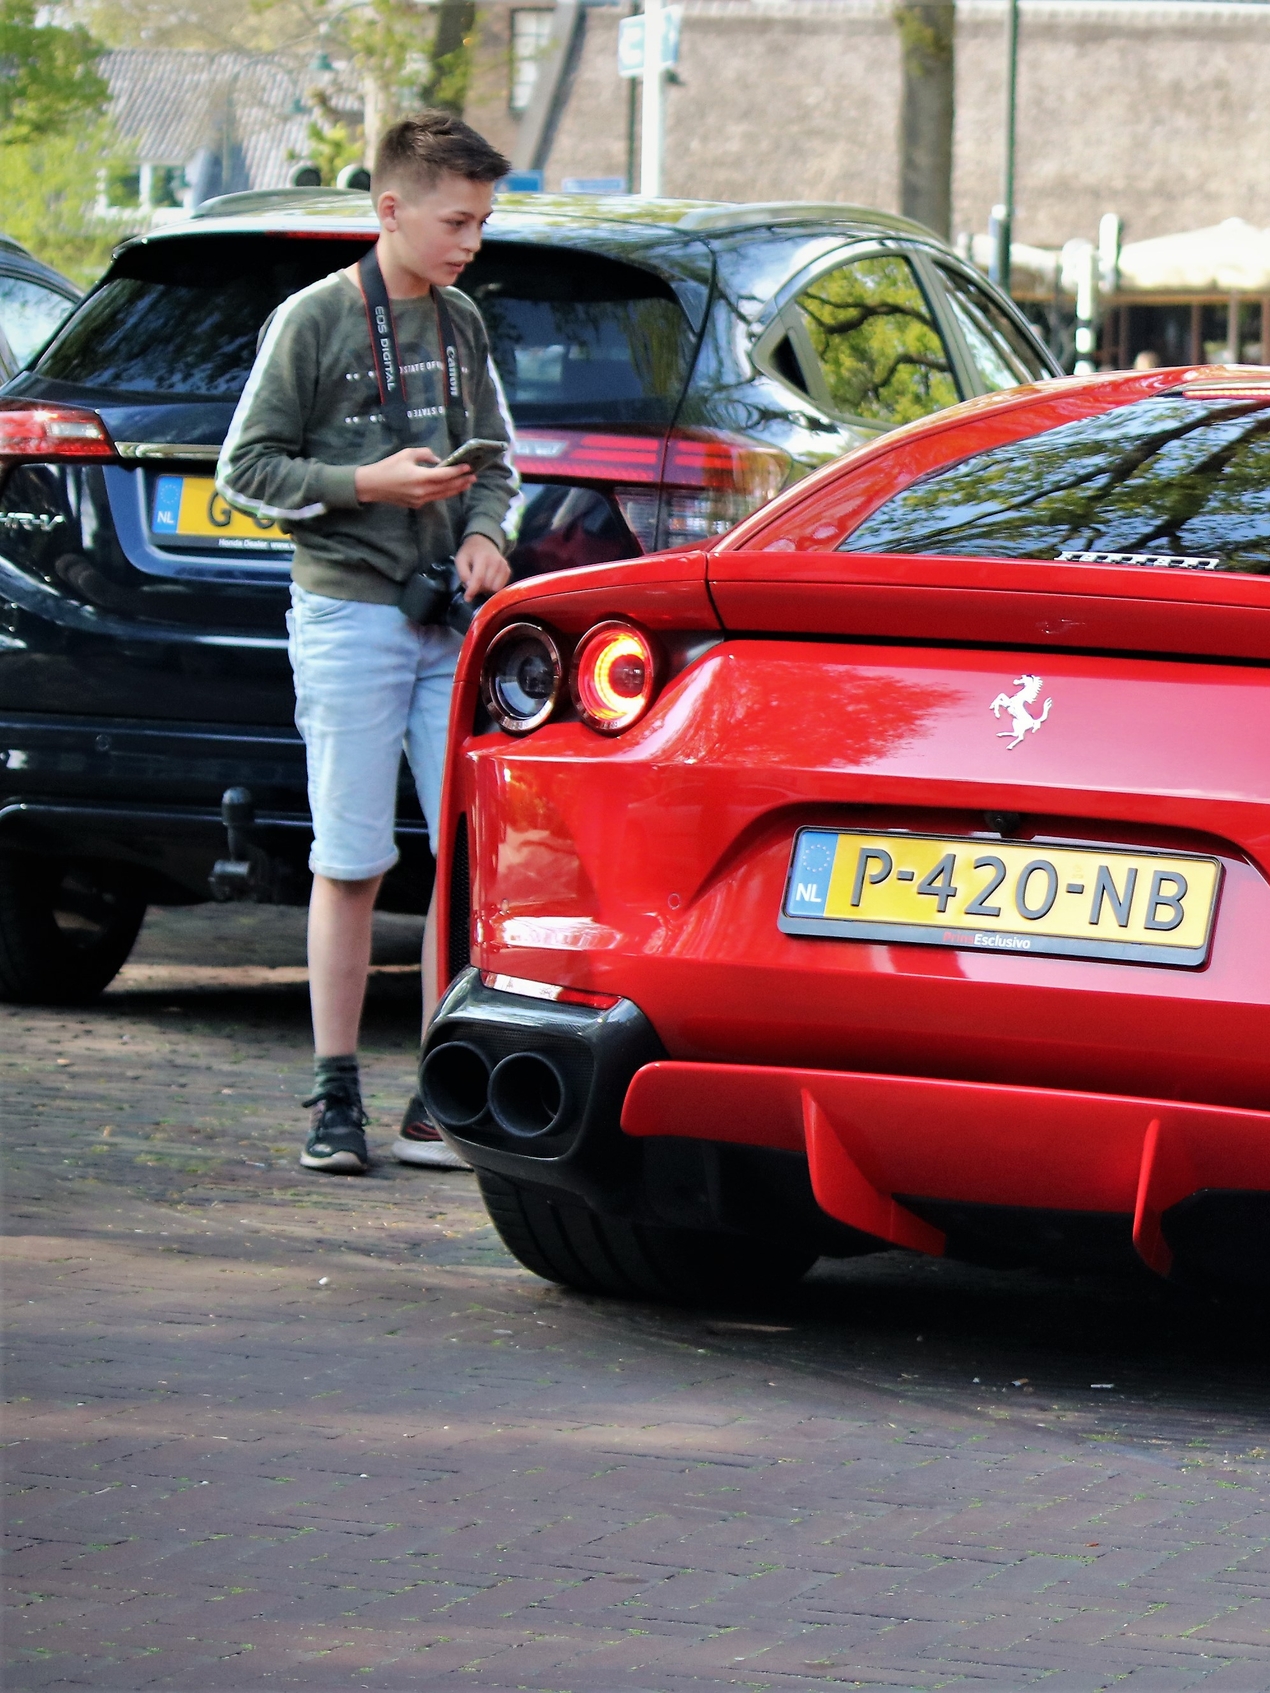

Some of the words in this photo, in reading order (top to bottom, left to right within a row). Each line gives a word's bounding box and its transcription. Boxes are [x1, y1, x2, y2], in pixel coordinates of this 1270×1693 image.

[374, 305, 388, 335] EOS
[380, 337, 396, 392] DIGITAL
[446, 345, 459, 397] Canon
[157, 510, 175, 525] NL
[1053, 550, 1220, 571] Ferrari
[795, 882, 822, 904] NL
[849, 846, 1189, 932] P-420-NB
